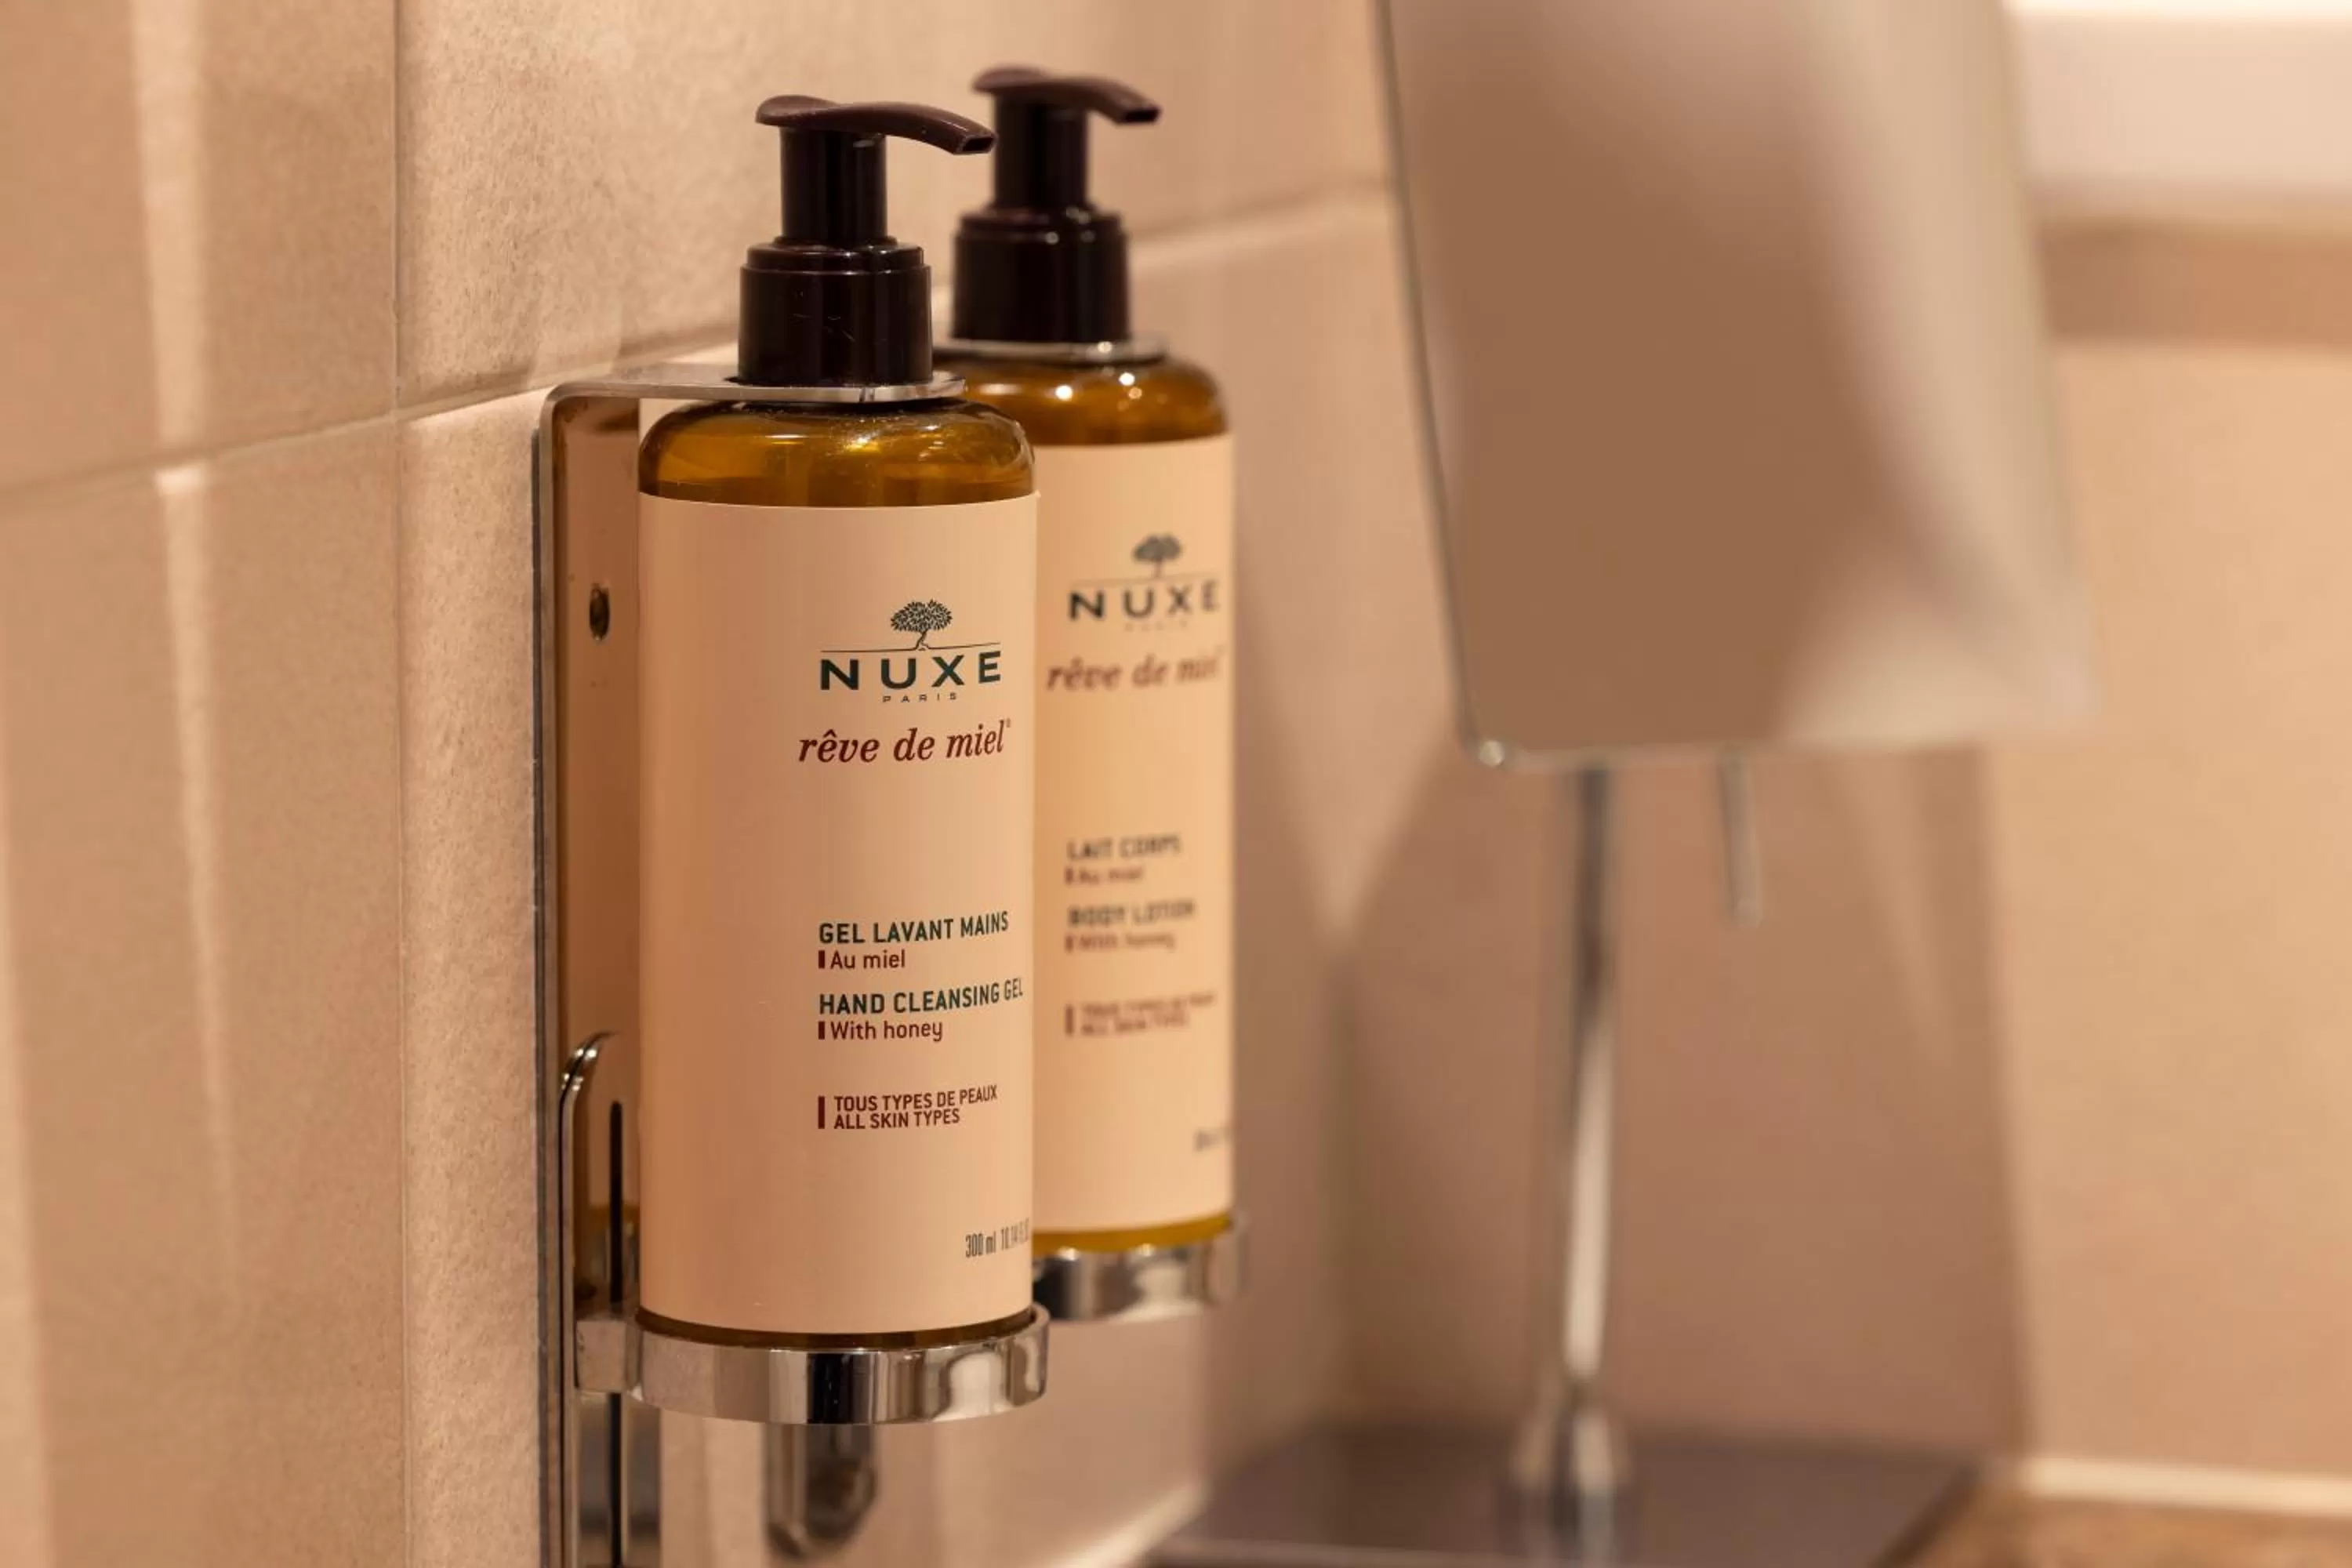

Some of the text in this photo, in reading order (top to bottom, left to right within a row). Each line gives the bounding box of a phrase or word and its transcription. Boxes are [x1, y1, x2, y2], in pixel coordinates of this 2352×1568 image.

[1067, 579, 1221, 621] NUXE
[819, 650, 1002, 691] NUXE
[882, 691, 957, 703] PARIS
[798, 718, 1006, 764] rêve de miel
[818, 910, 1009, 944] GEL LAVANT MAINS
[829, 949, 906, 970] Au miel
[818, 977, 1024, 1014] HAND CLEANSING GEL
[829, 1020, 944, 1043] With honey
[833, 1084, 999, 1112] TOUS TYPES DE PEAUX
[833, 1108, 960, 1130] ALL SKIN TYPES
[965, 1232, 984, 1258] 300
[985, 1230, 996, 1254] ml
